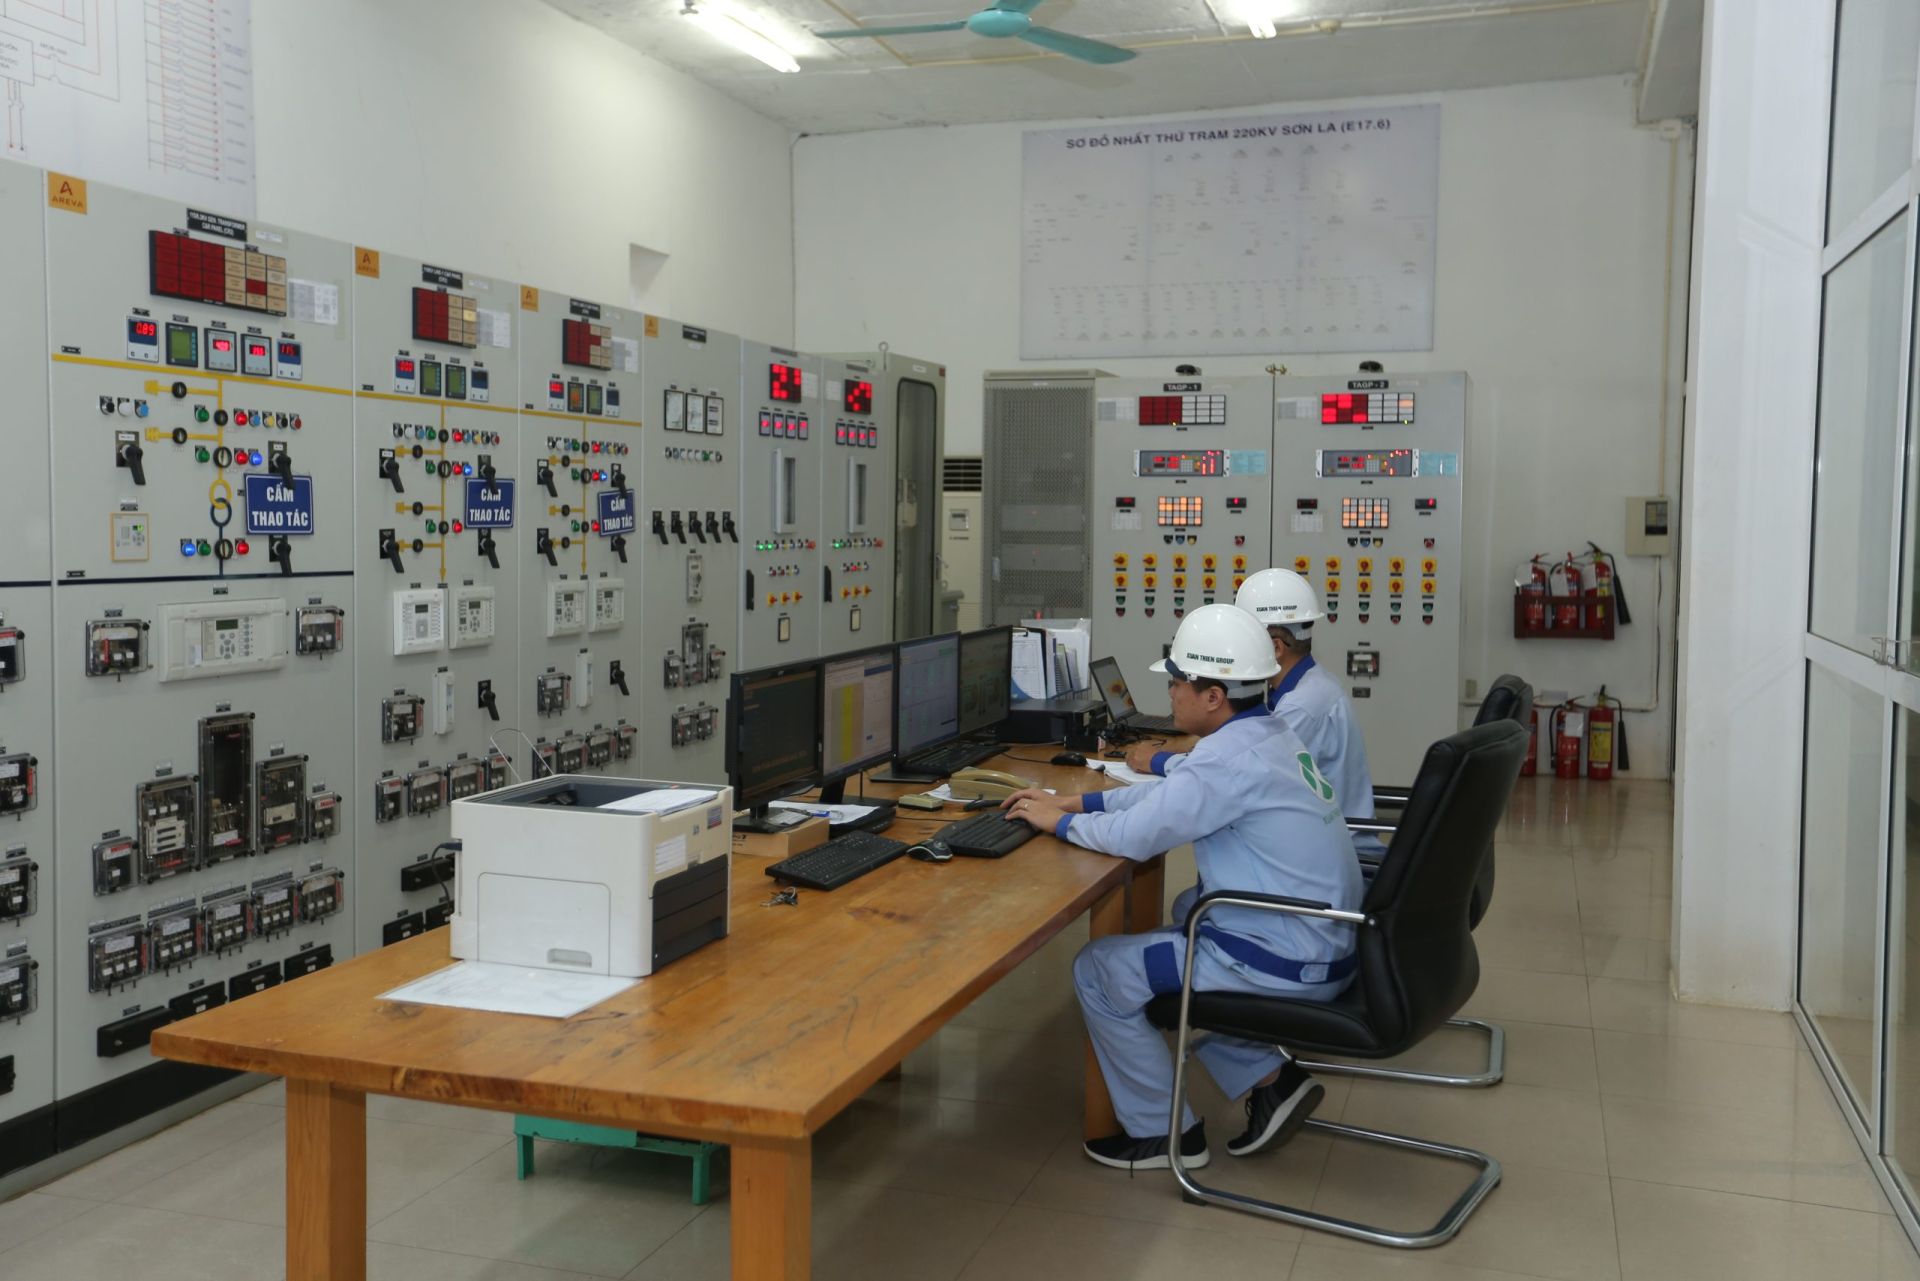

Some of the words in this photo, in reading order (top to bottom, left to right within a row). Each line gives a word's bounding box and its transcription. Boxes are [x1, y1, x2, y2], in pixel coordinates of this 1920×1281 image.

[1066, 136, 1087, 149] SƠ
[1232, 125, 1278, 139] 220KV
[1317, 122, 1337, 134] LA
[1340, 118, 1391, 134] (E17.6)
[52, 195, 84, 208] AREVA
[252, 511, 284, 527] THAO
[286, 509, 309, 527] TÁC
[470, 508, 492, 522] THAO
[494, 506, 511, 522] TÁC
[604, 517, 621, 531] THAO
[621, 514, 633, 528] TÁC
[1216, 656, 1234, 664] GROUP
